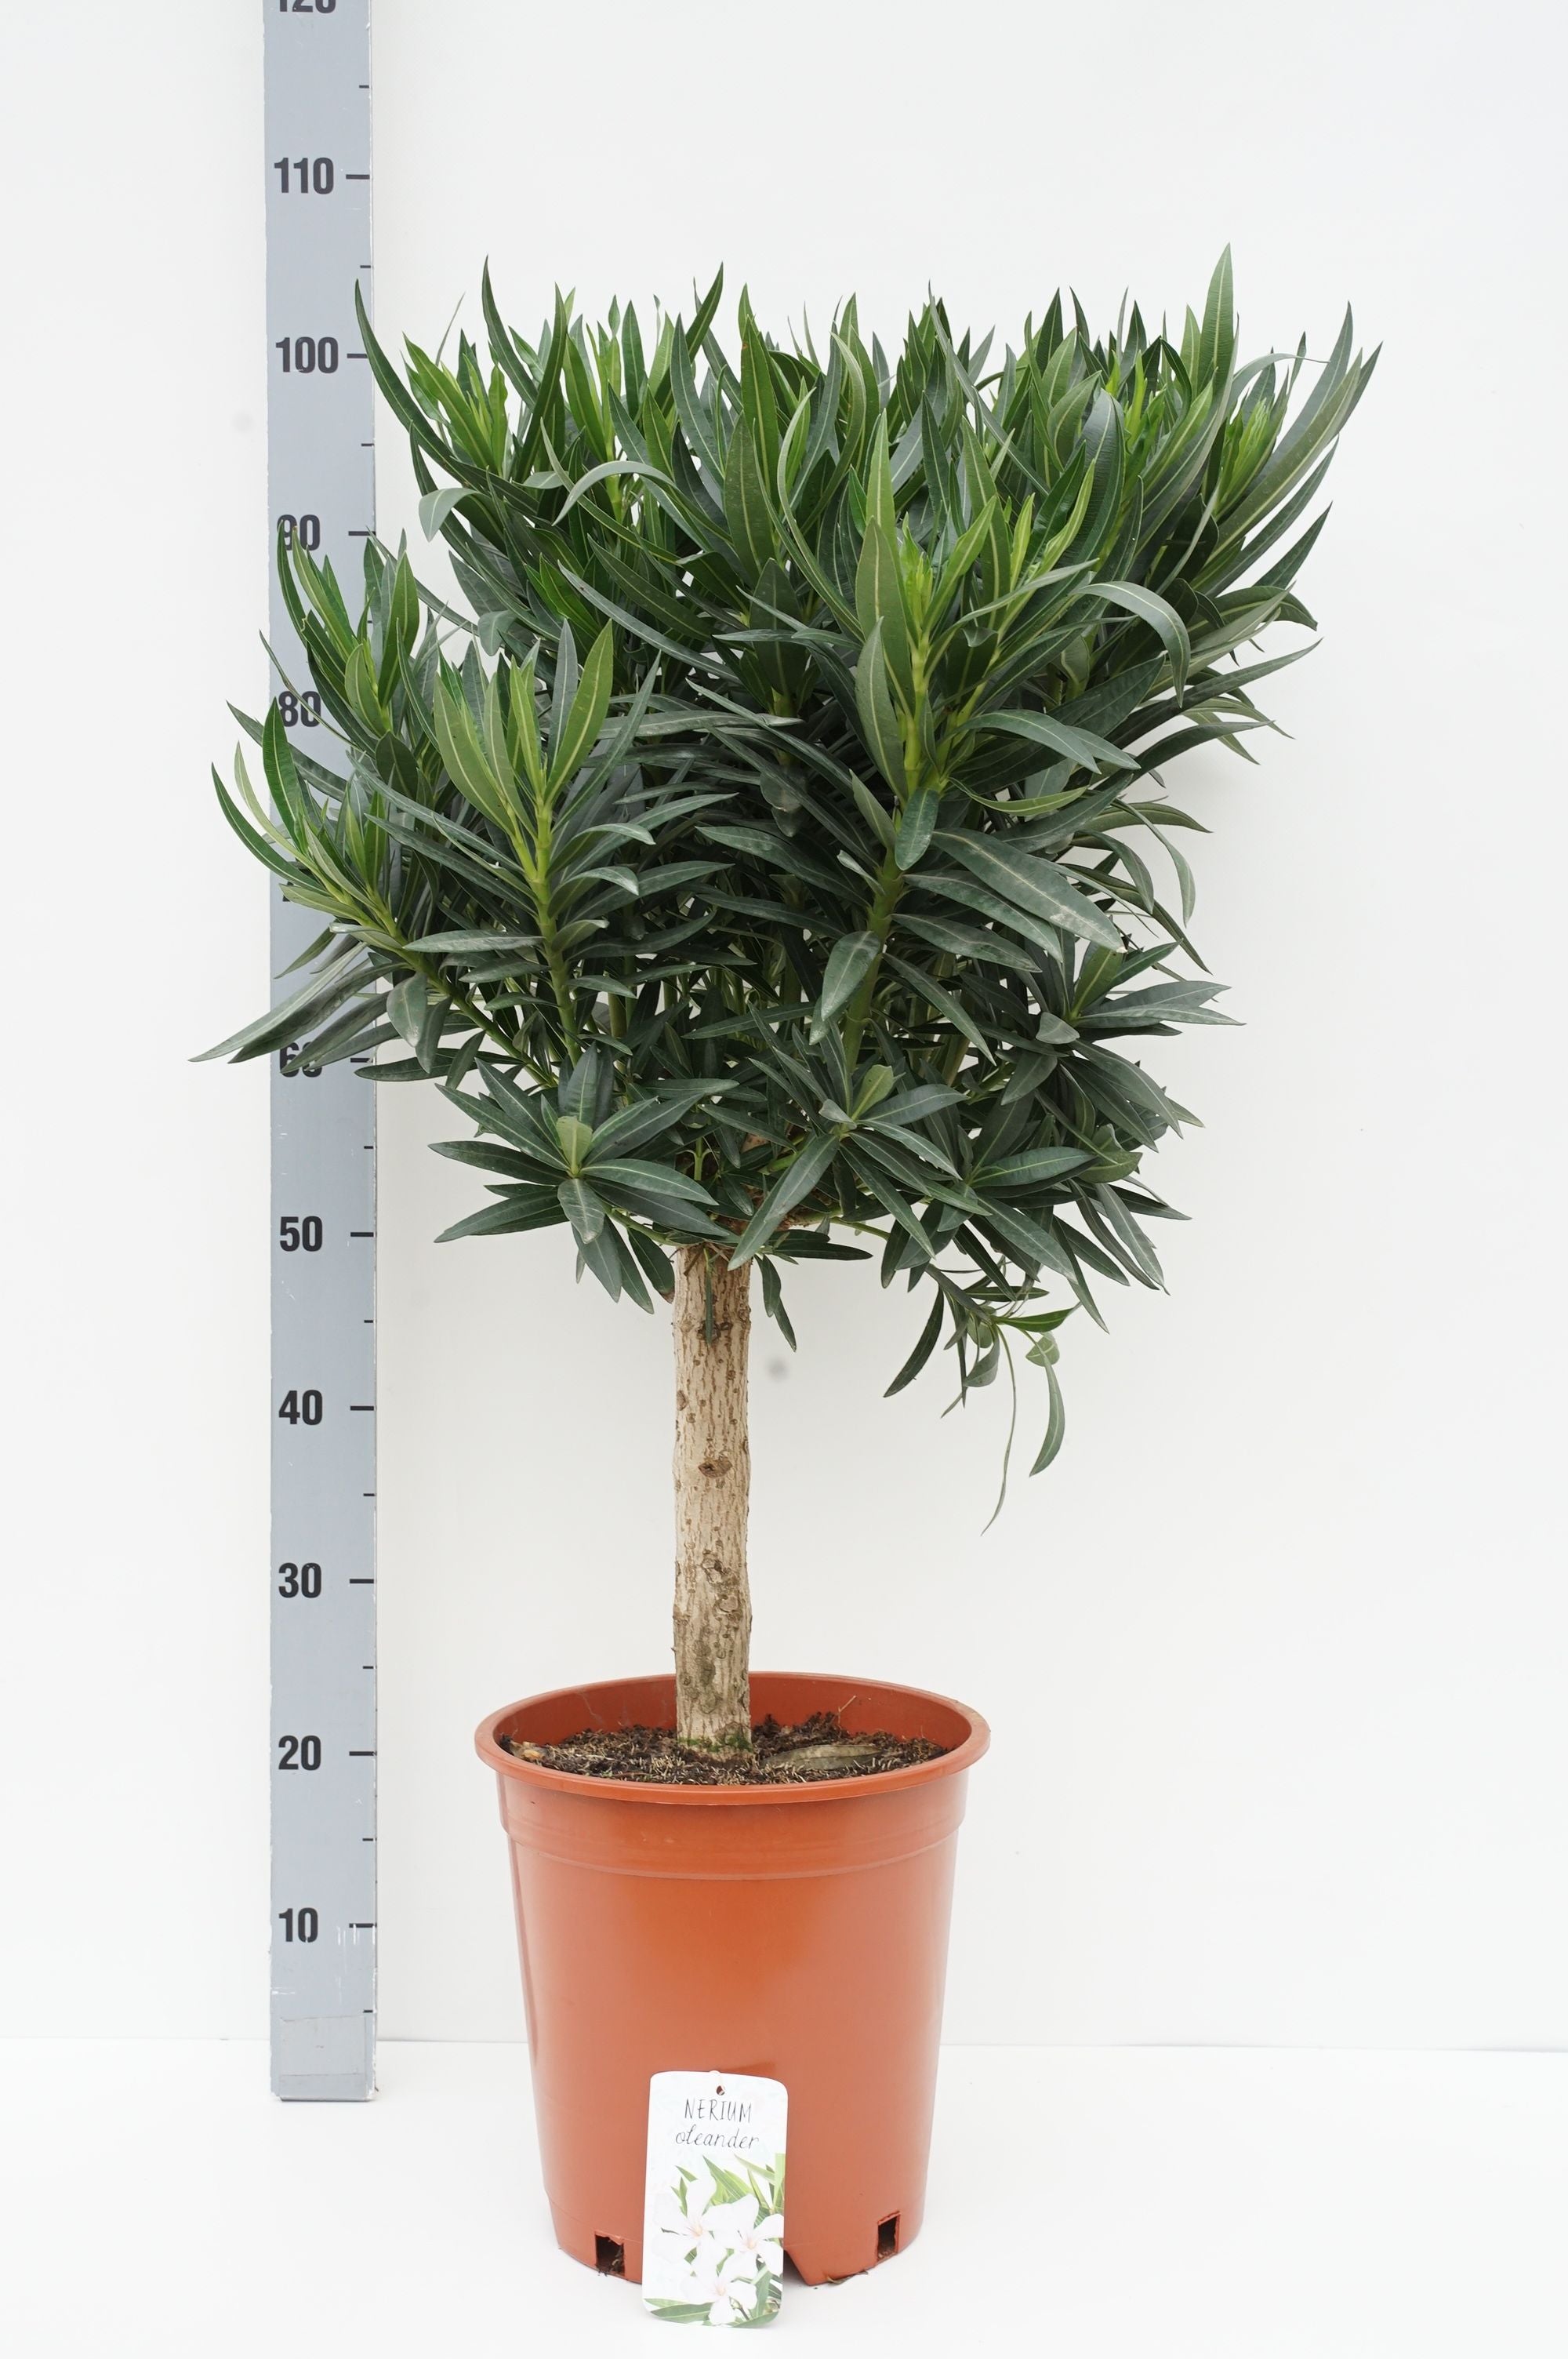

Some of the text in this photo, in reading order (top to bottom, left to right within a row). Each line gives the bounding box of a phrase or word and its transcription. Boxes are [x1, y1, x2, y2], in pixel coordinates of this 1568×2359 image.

[274, 157, 335, 194] 110
[275, 336, 339, 373] 100
[277, 514, 321, 551] 90
[278, 690, 321, 728] 80
[279, 1216, 323, 1252] 50
[278, 1389, 323, 1426] 40
[278, 1562, 322, 1598] 30
[278, 1735, 321, 1771] 20
[278, 1907, 319, 1943] 10
[684, 2097, 752, 2123] NERIUM
[675, 2124, 760, 2150] oleander
